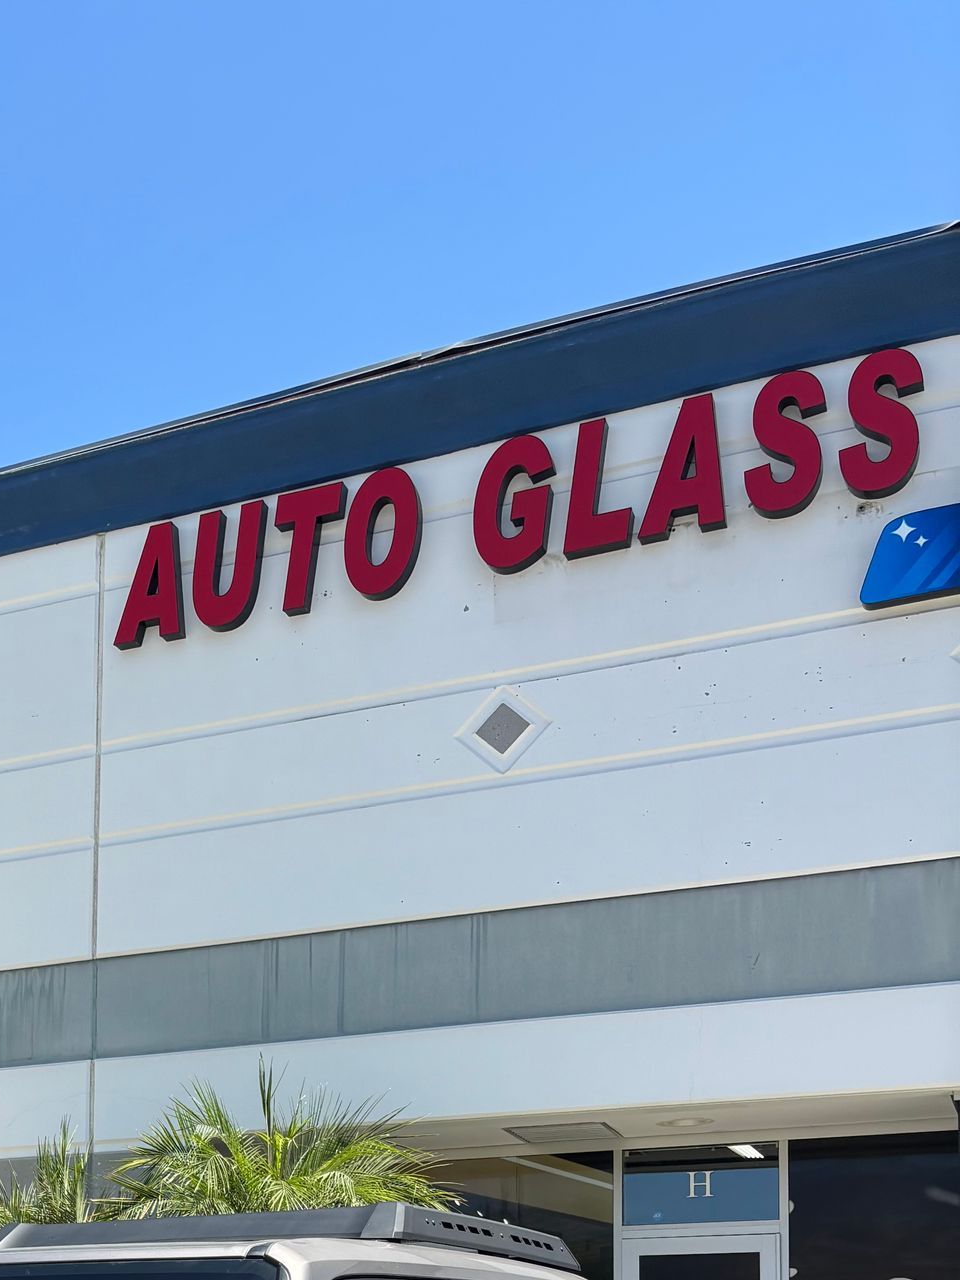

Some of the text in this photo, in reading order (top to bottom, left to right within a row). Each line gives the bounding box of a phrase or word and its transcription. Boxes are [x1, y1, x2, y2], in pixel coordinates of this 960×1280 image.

[114, 348, 924, 650] AUTO GLASS
[686, 1170, 714, 1198] H
